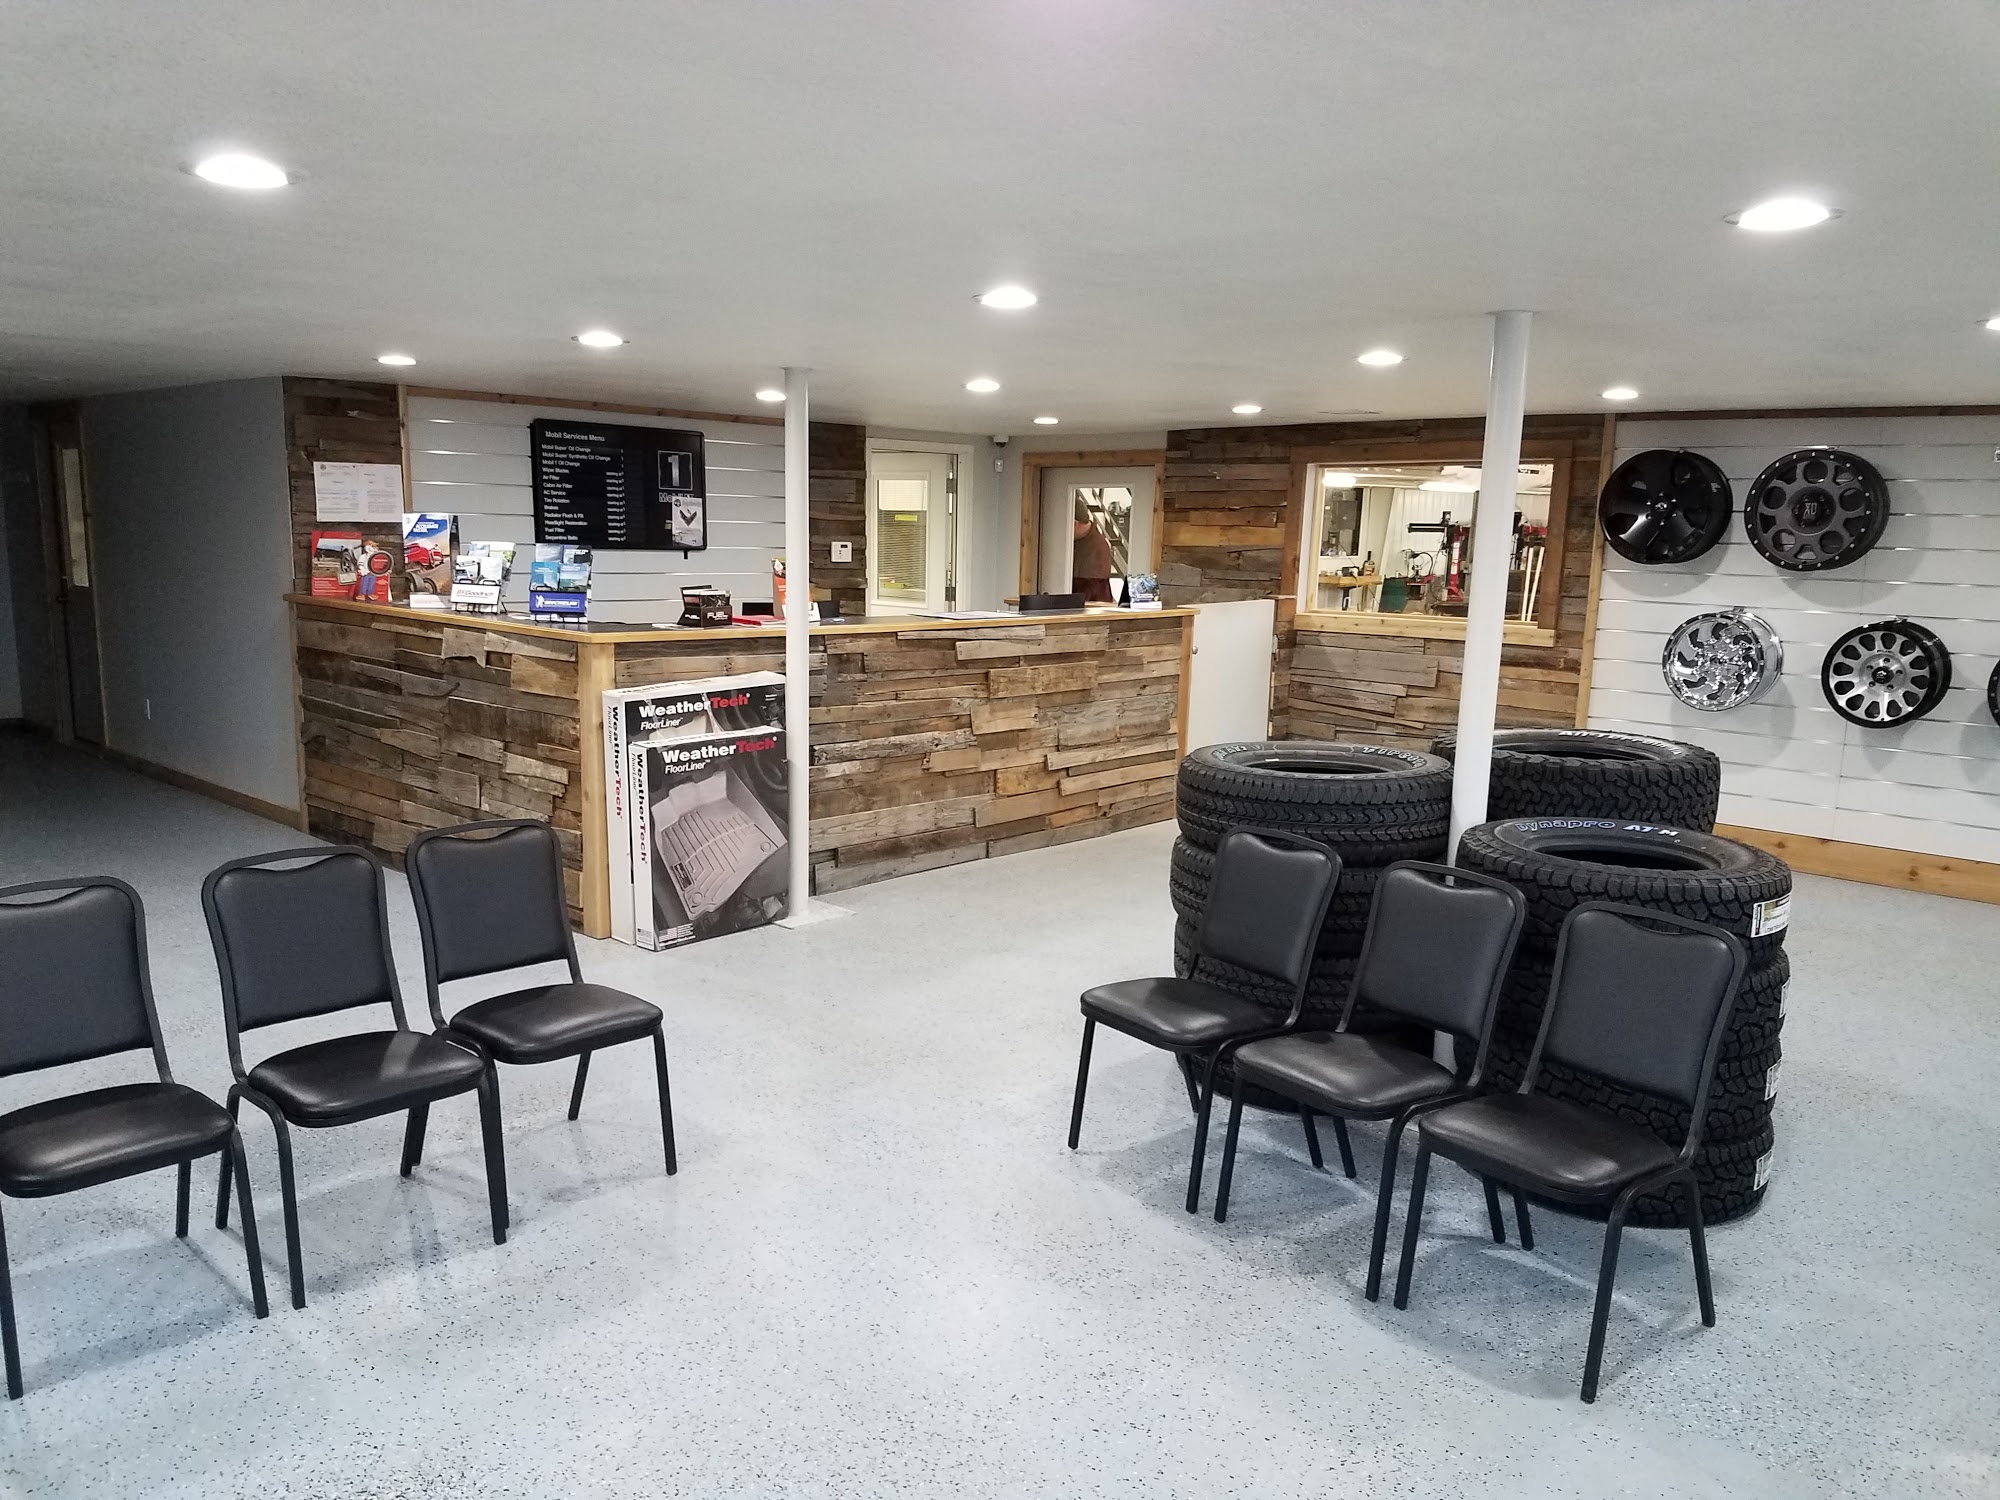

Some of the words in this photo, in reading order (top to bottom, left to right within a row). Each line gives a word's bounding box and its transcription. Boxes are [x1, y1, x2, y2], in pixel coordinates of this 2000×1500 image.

[545, 431, 562, 439] Mobil
[563, 432, 588, 440] Services
[639, 693, 750, 717] WeatherTech
[640, 718, 683, 731] FloorLiner
[662, 737, 776, 763] WeatherTech
[665, 760, 709, 774] FloorLiner
